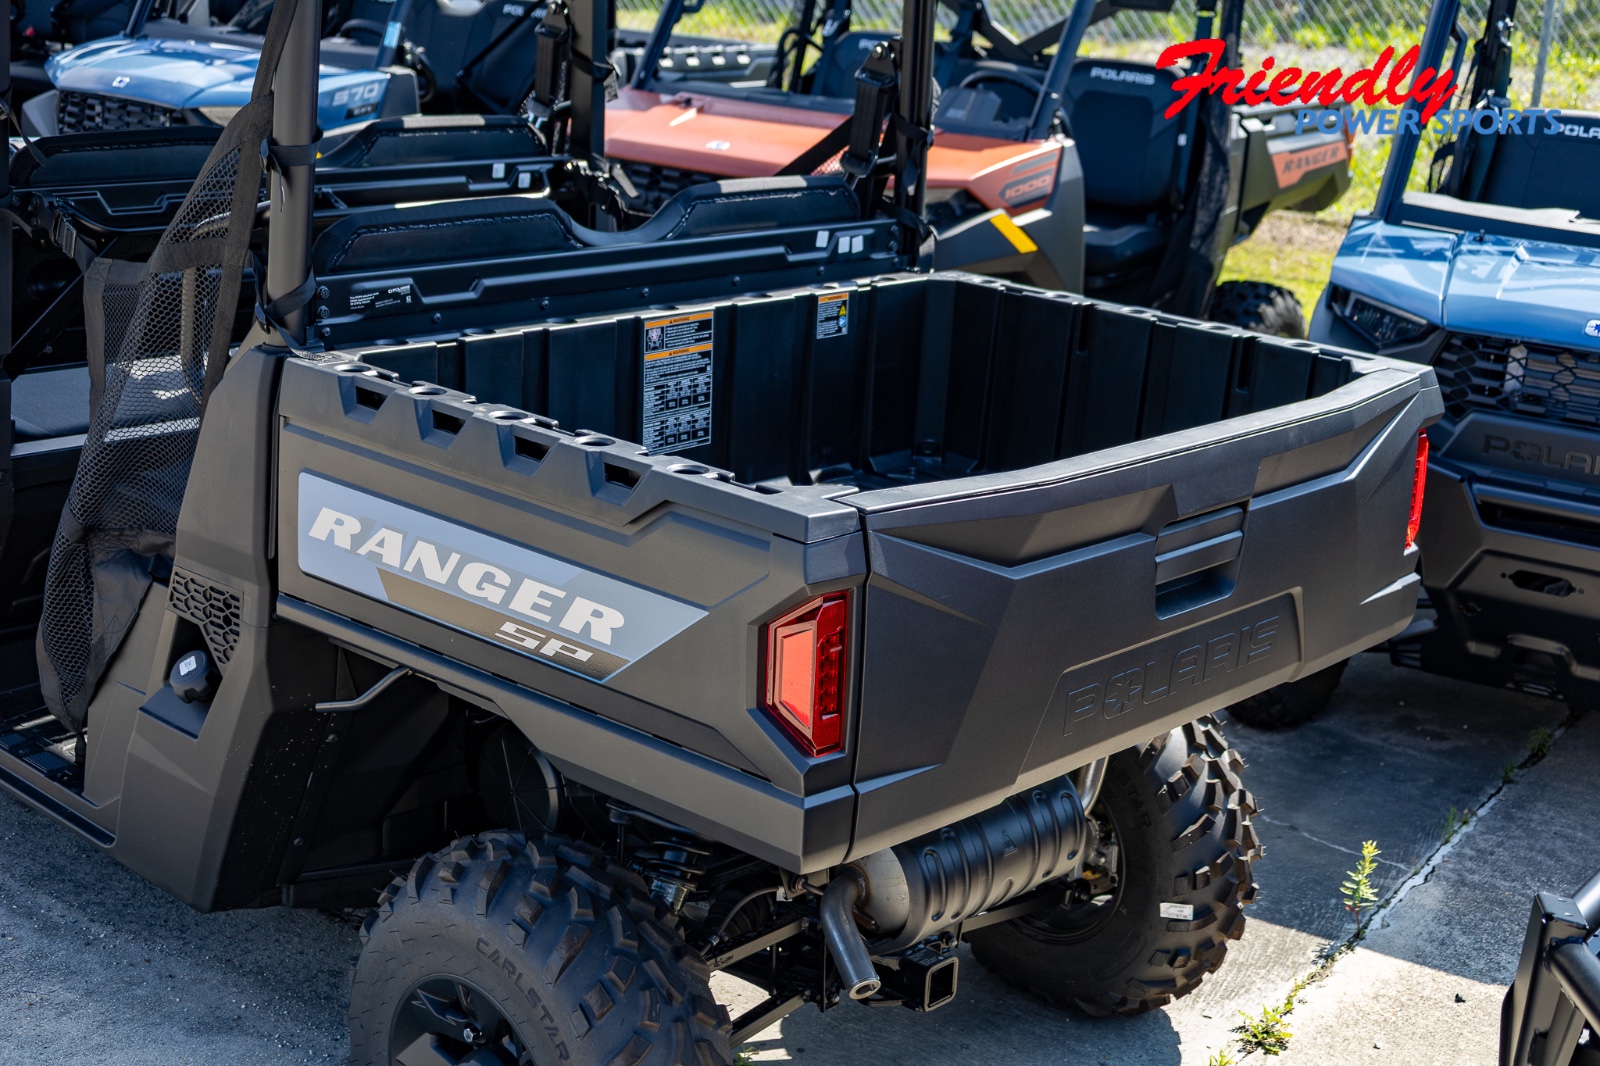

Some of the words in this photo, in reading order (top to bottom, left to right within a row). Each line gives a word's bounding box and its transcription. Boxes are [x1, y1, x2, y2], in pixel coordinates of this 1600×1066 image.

[1090, 66, 1156, 85] POLARIS
[1283, 146, 1340, 174] RANGER
[1005, 174, 1051, 199] 1000
[308, 507, 625, 646] RANGER
[494, 621, 594, 662] SP
[1063, 615, 1280, 737] POLARIS
[475, 936, 571, 1062] CARLSTAR
